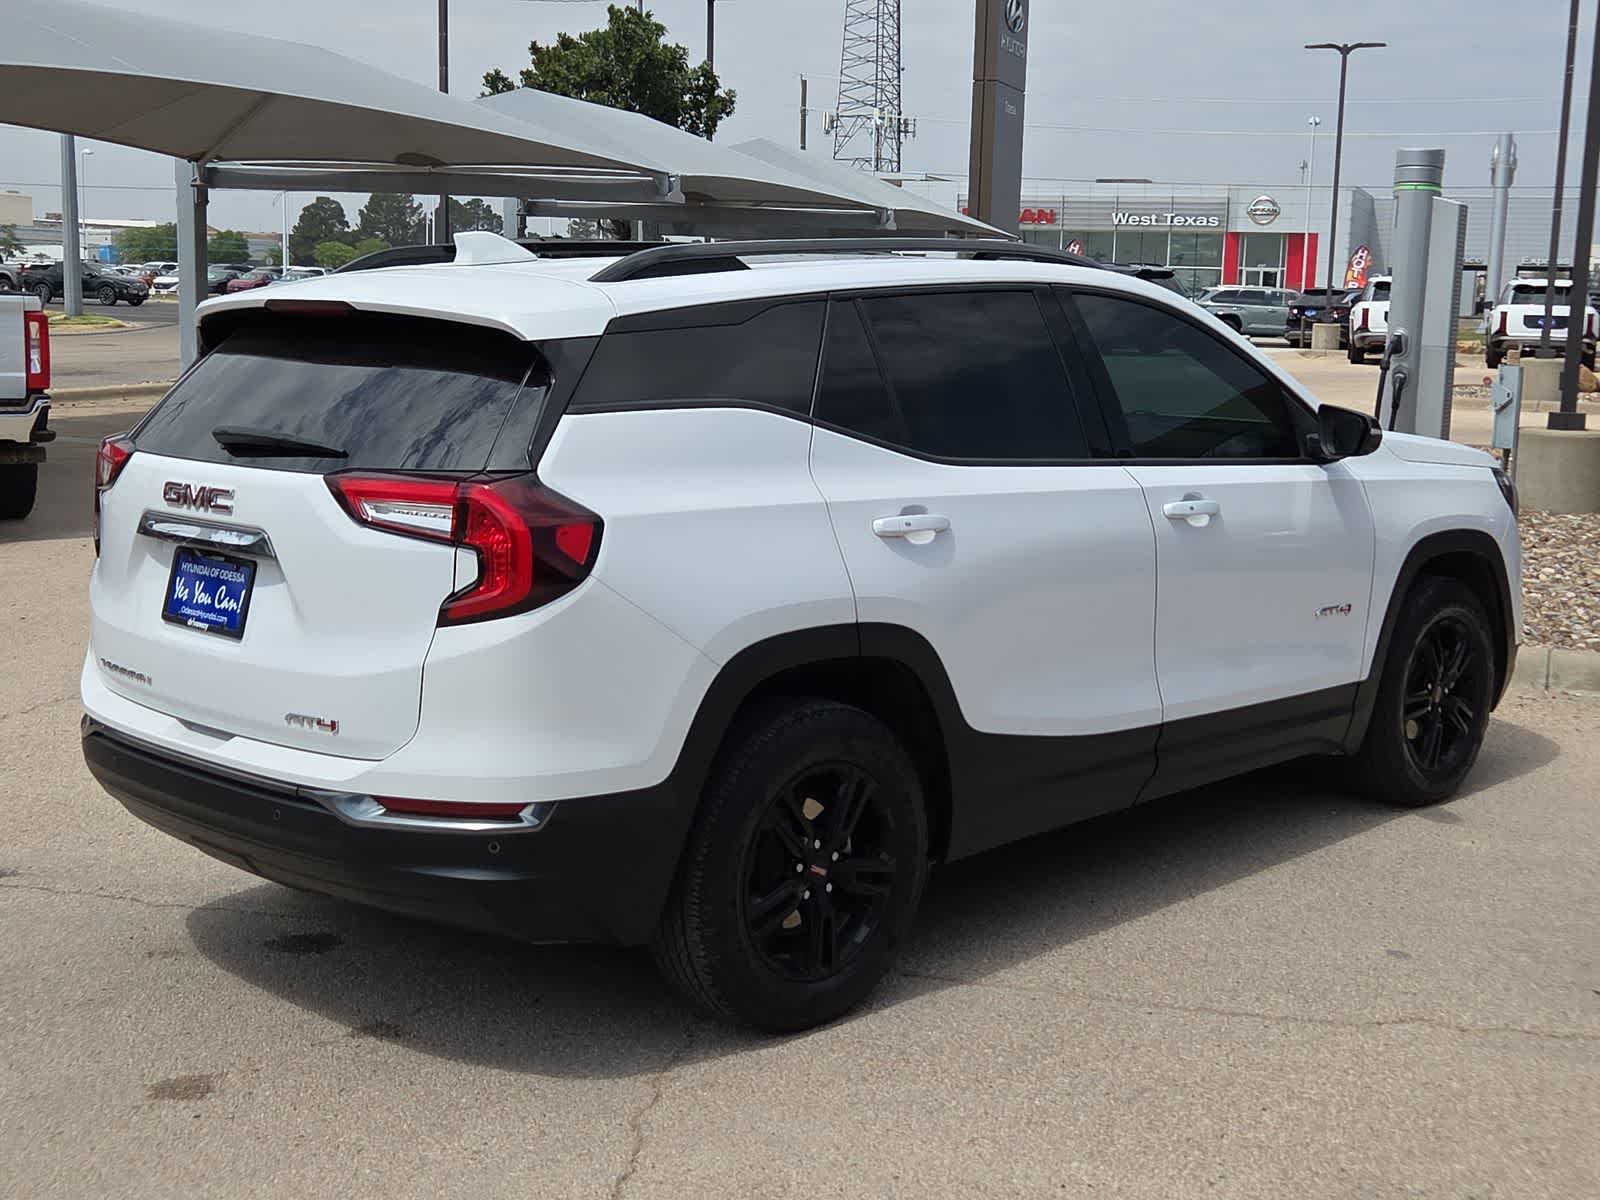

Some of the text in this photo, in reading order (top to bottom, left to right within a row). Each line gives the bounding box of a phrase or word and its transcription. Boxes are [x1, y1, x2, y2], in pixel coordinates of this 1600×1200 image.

[1112, 212, 1220, 227] West Texas
[163, 481, 235, 516] GMC
[181, 562, 246, 583] HYUNDAI OF ODESSA
[174, 576, 246, 613] Yes You Can!
